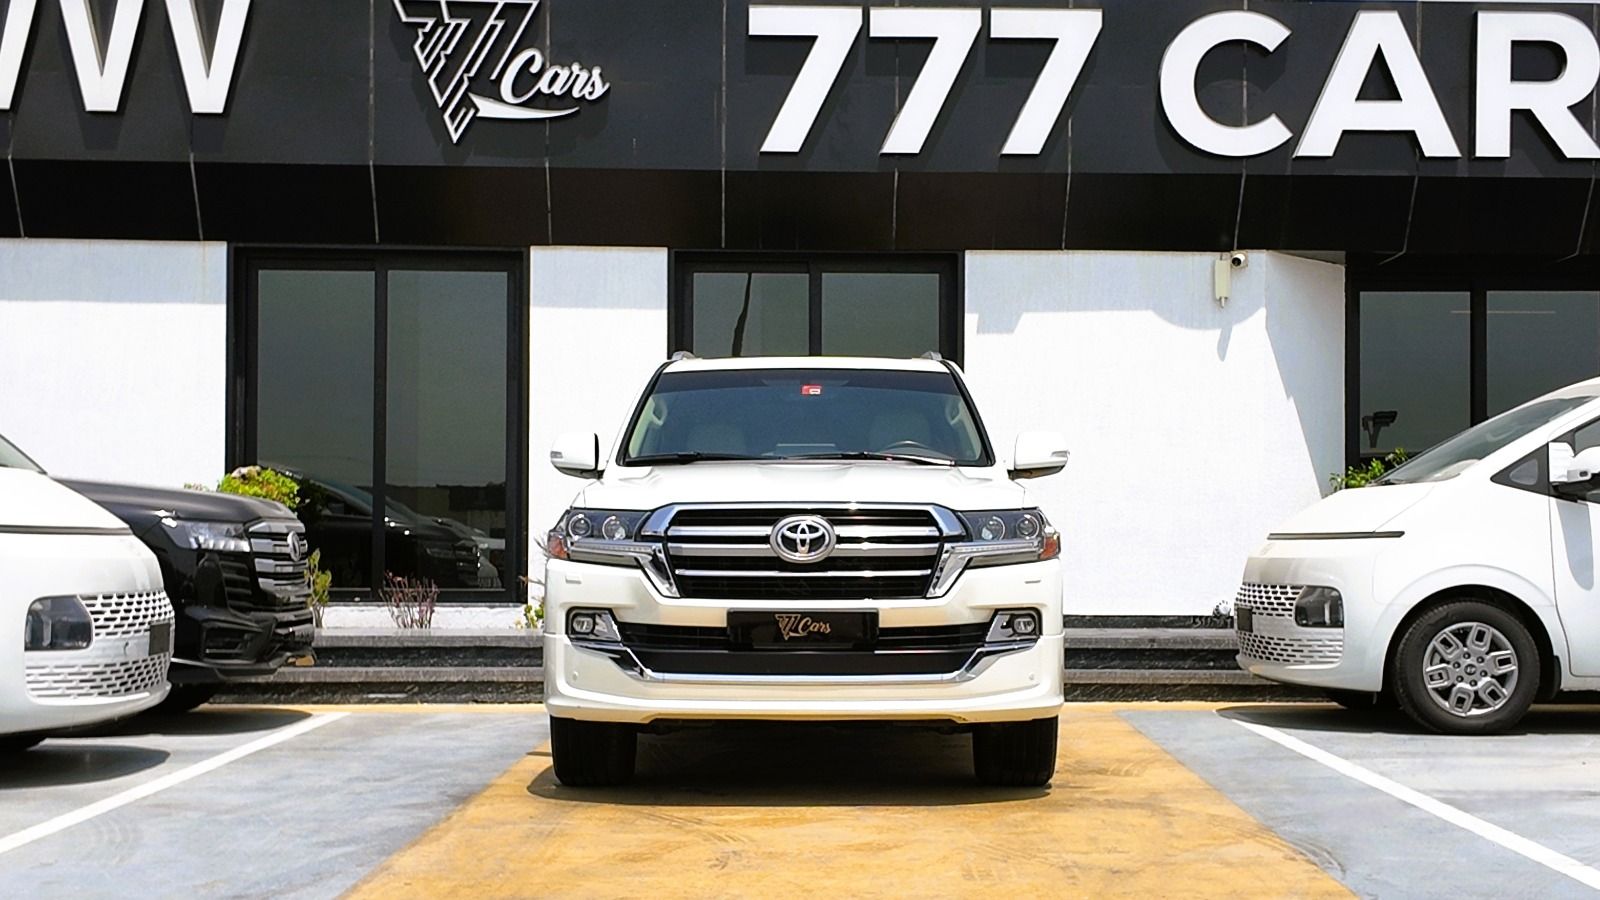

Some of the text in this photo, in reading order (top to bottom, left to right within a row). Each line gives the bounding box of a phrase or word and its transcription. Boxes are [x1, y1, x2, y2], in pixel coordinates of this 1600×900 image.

[500, 48, 610, 104] Cars
[748, 6, 1600, 159] 777 CAR
[798, 617, 831, 634] Cars
